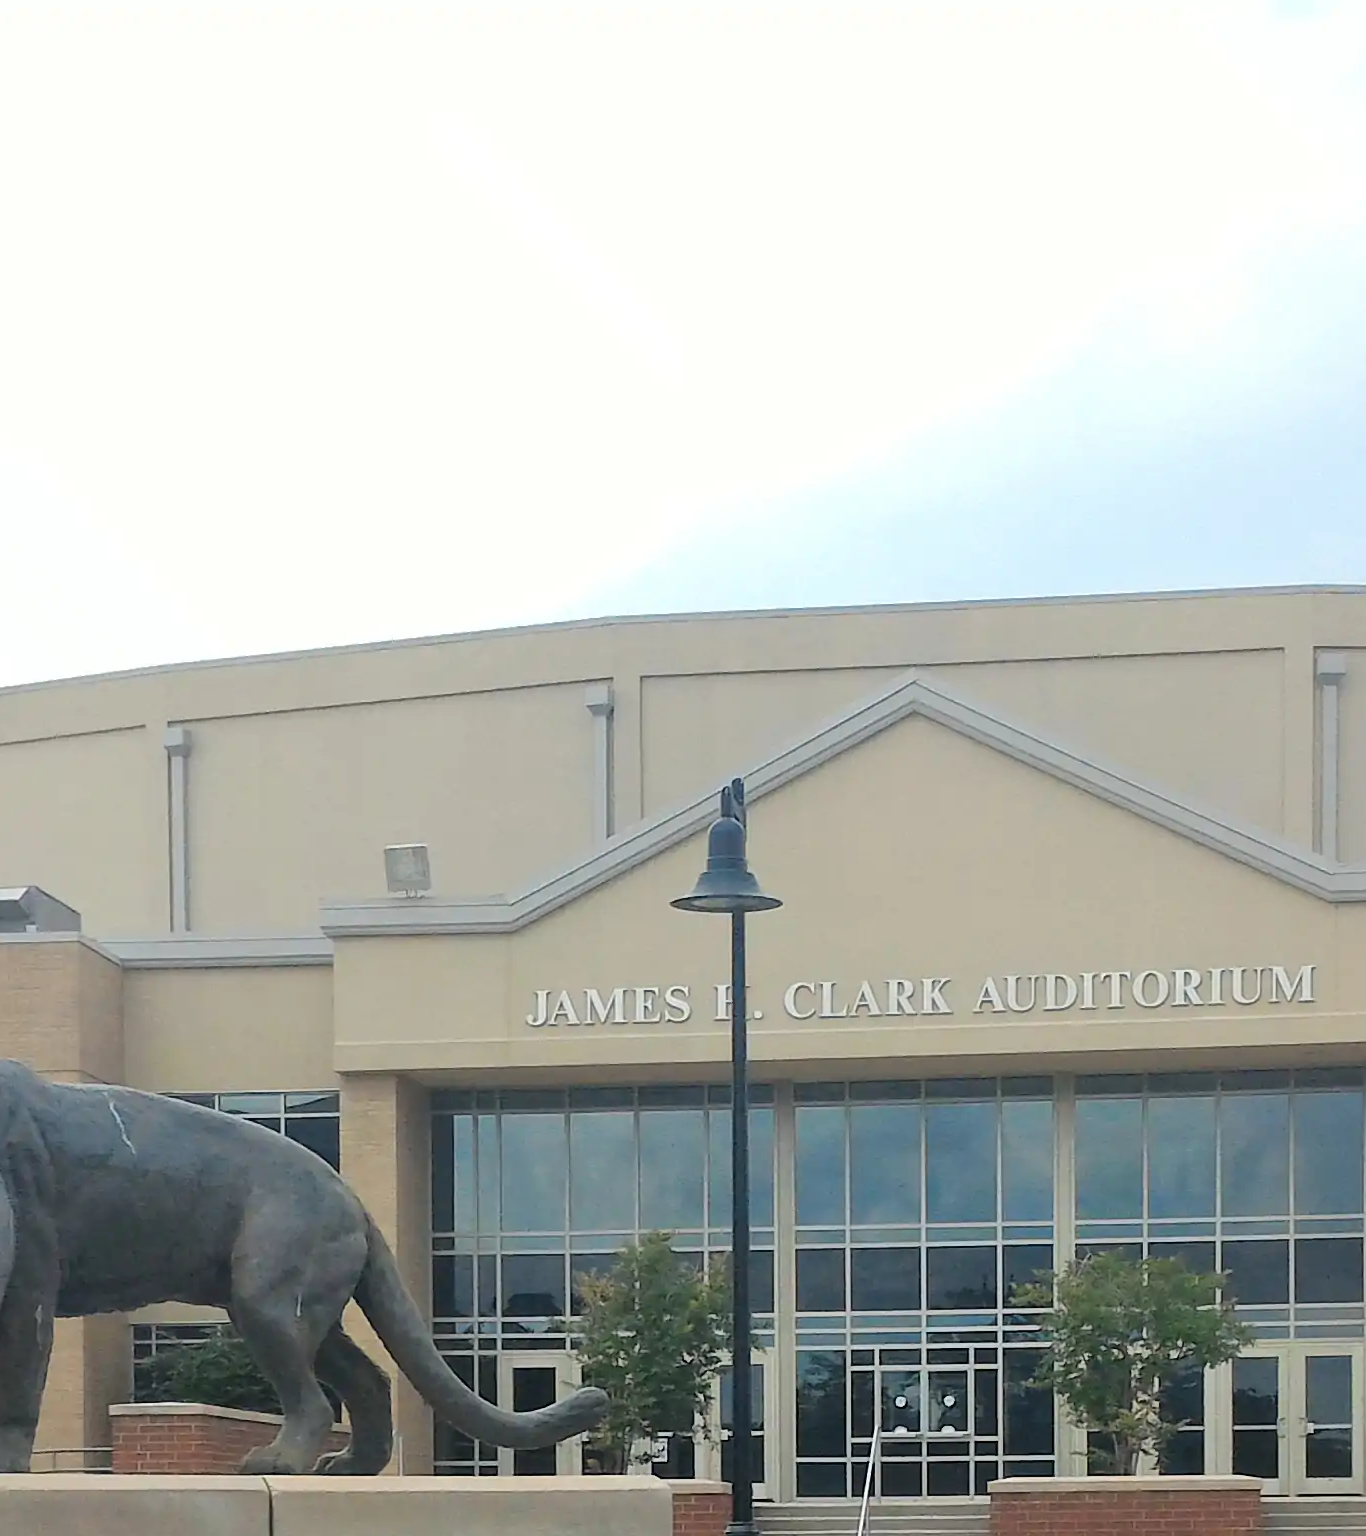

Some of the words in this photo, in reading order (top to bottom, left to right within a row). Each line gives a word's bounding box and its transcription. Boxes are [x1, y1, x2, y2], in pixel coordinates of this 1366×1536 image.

[526, 986, 691, 1026] JAMES
[782, 977, 953, 1019] CLARK
[972, 964, 1317, 1013] AUDITORIUM
